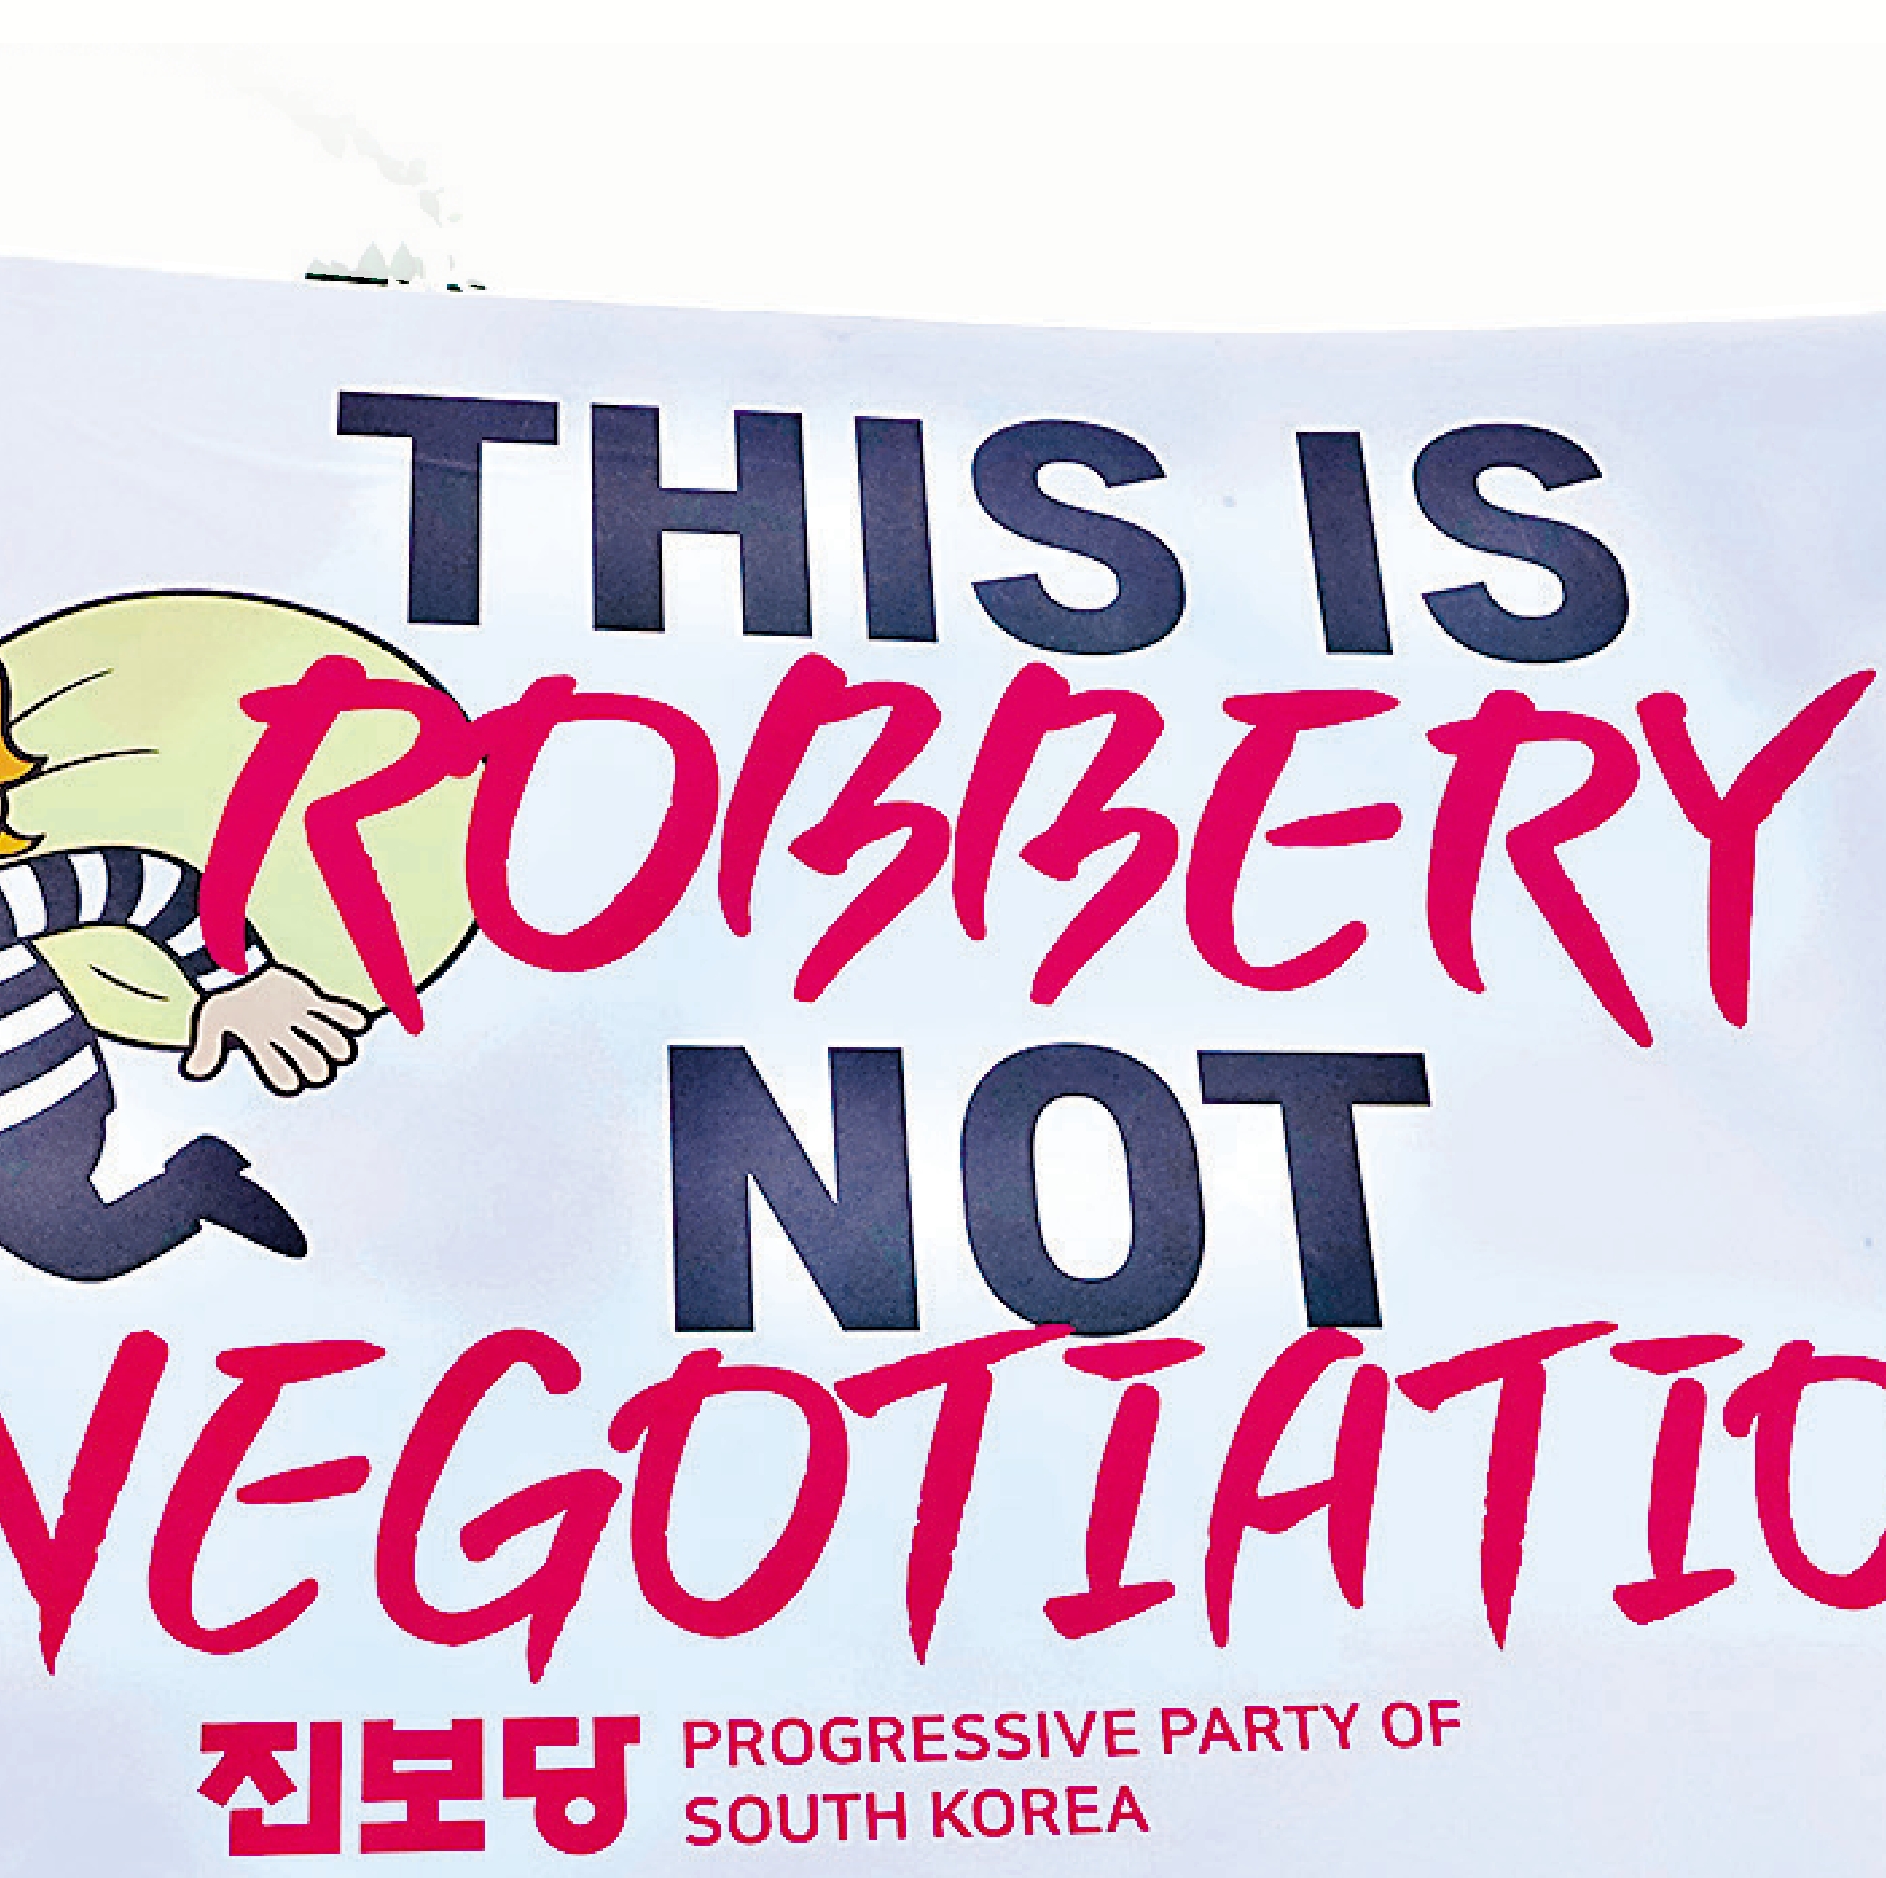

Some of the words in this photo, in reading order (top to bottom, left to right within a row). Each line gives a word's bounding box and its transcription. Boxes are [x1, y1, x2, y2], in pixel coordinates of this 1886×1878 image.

[337, 391, 1187, 655] THIS
[1296, 423, 1630, 664] IS
[198, 652, 1877, 1048] ROBBERY
[666, 1043, 1431, 1336] NOT
[197, 1715, 641, 1857] 진보당
[683, 1708, 1140, 1769] PROGRESSIVE
[1160, 1701, 1360, 1755] PARTY
[1381, 1698, 1461, 1749] OF
[684, 1791, 908, 1847] SOUTH
[931, 1784, 1151, 1838] KOREA
